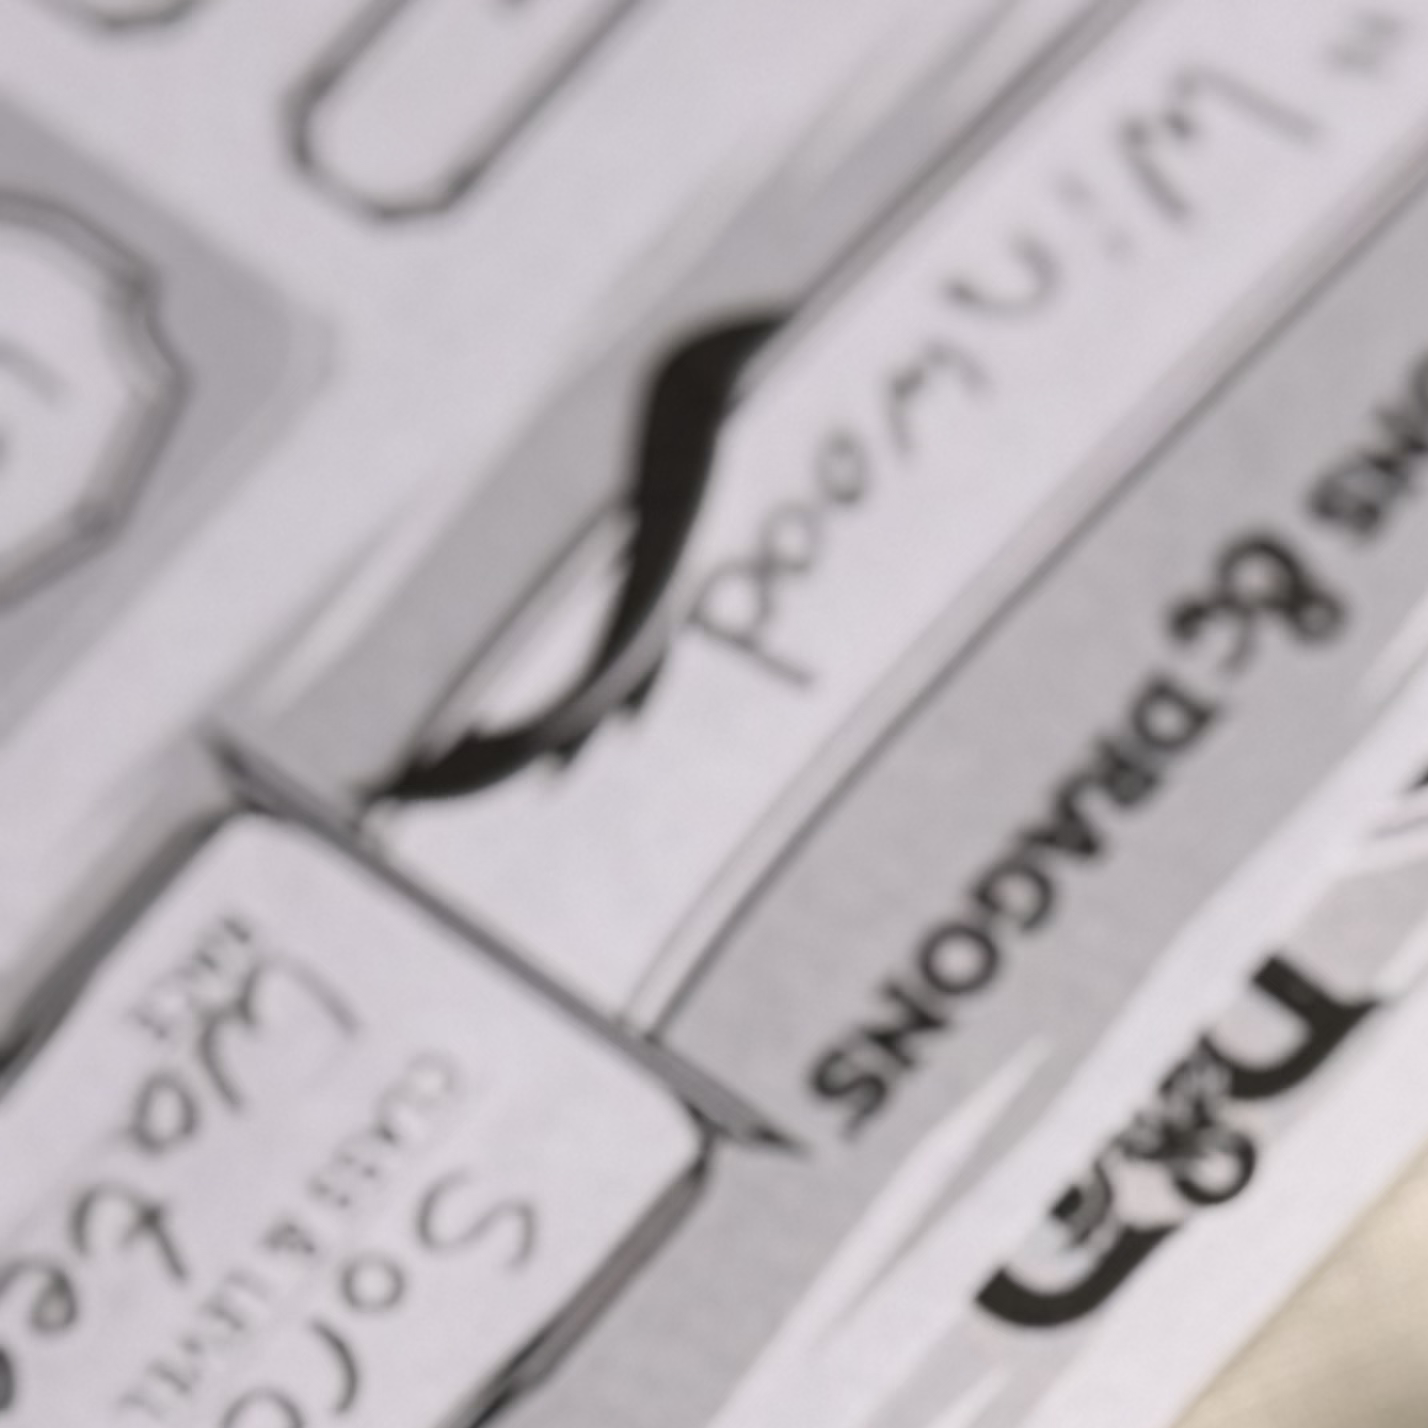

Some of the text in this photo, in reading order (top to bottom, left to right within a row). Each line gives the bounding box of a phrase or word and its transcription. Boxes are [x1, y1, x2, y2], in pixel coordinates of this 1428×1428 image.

[1160, 528, 1352, 676] &
[806, 666, 1224, 1142] DRAGONS
[0, 945, 362, 1412] Wate
